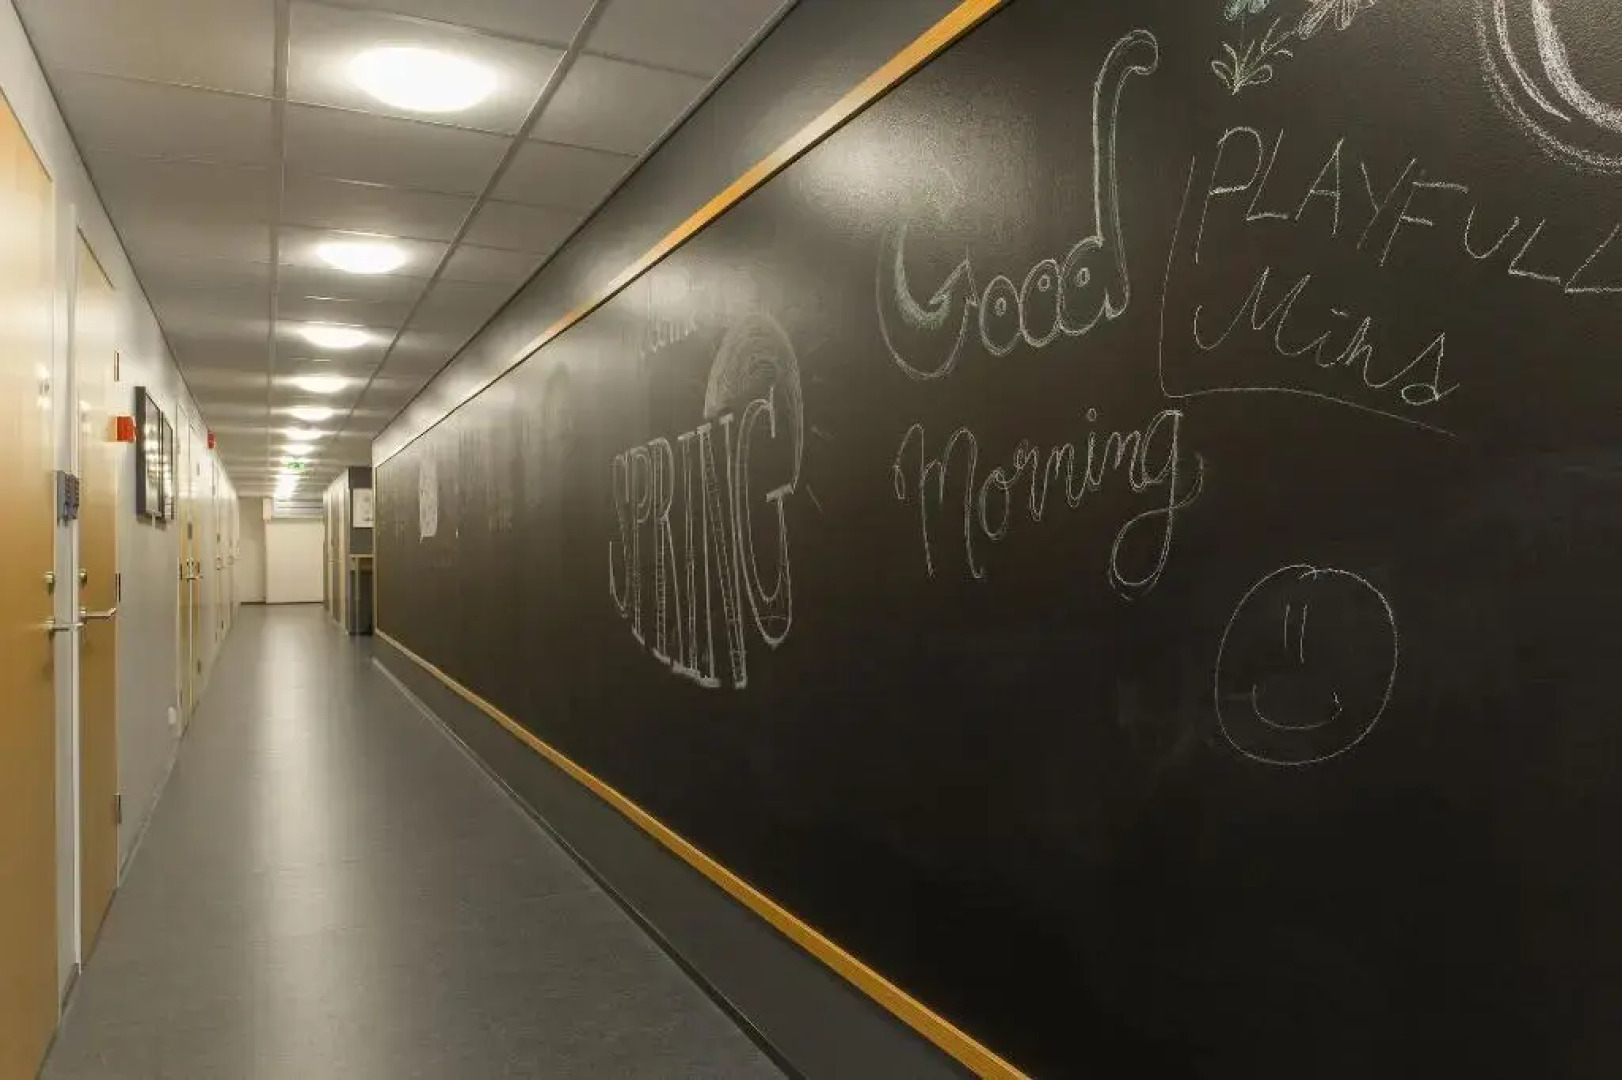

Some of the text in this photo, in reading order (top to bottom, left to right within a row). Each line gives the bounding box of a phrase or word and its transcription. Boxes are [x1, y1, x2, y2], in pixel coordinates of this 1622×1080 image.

[876, 29, 1159, 379] Good
[608, 385, 797, 689] SPRING
[893, 407, 1204, 602] Morning
